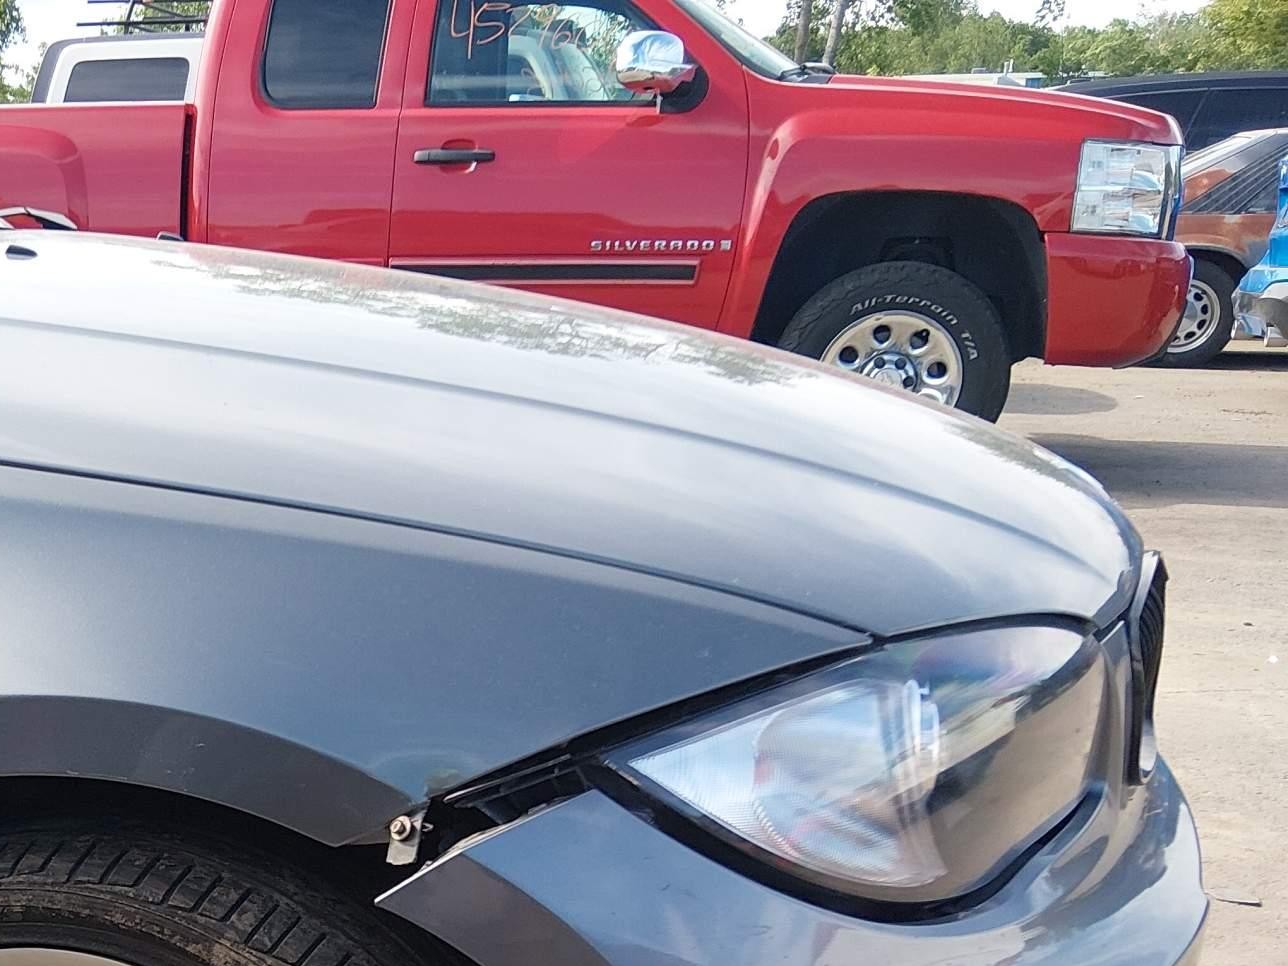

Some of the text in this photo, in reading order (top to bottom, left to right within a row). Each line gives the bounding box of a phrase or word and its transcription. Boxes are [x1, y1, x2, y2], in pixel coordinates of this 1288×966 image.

[590, 240, 715, 251] SILVERADO
[849, 294, 979, 361] All-Terrain T/A
